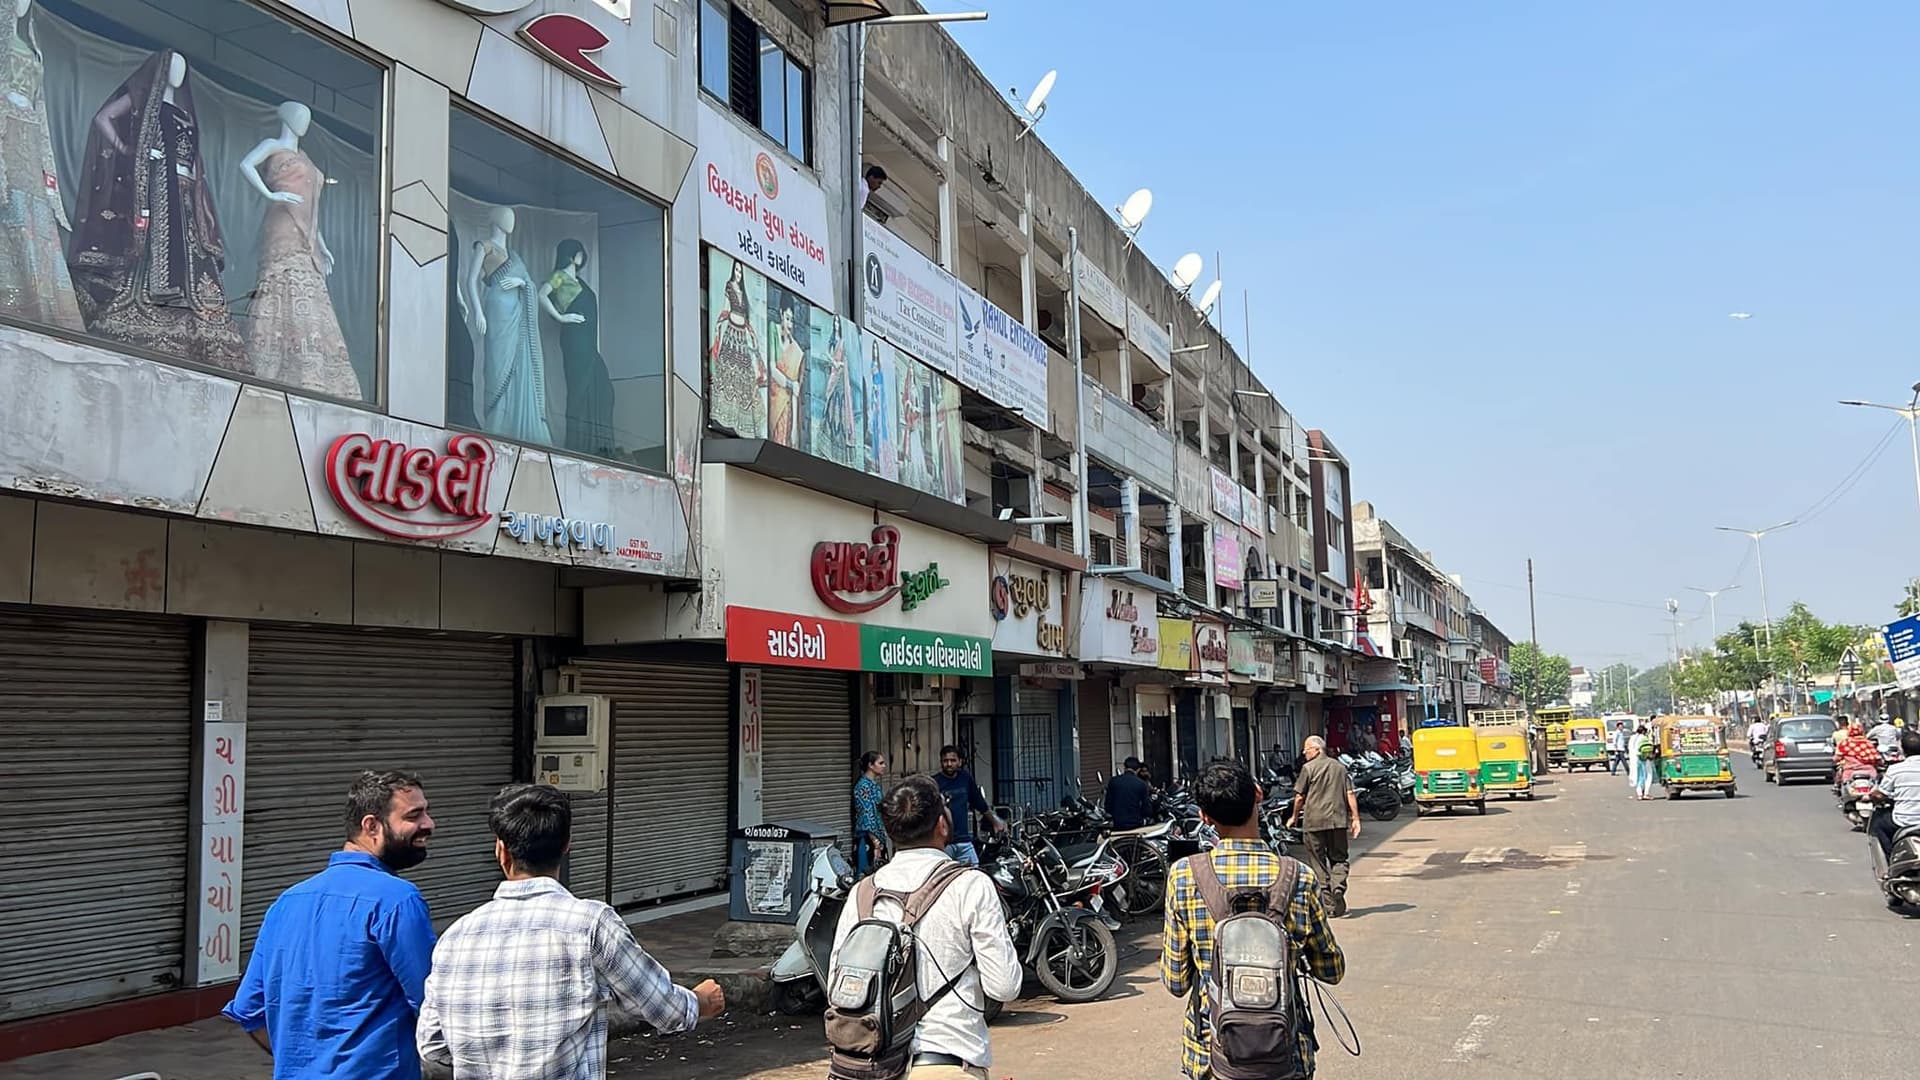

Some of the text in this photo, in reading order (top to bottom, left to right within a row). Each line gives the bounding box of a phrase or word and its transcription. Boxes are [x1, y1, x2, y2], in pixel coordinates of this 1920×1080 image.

[707, 162, 758, 221] વિશ્વકર્મા
[762, 207, 785, 242] યુવા
[789, 220, 826, 265] સંગઠન
[738, 229, 806, 287] પ્રદેશ કાર્યાલય
[899, 297, 911, 318] Tax
[911, 307, 945, 338] Consultant
[982, 300, 1008, 339] RAHUL
[1009, 318, 1048, 368] ENTERPRISE
[324, 433, 493, 540] લાડલી
[629, 538, 639, 548] GST
[767, 621, 826, 660] સાડીઓ
[880, 636, 922, 668] બ્રાઈડલ
